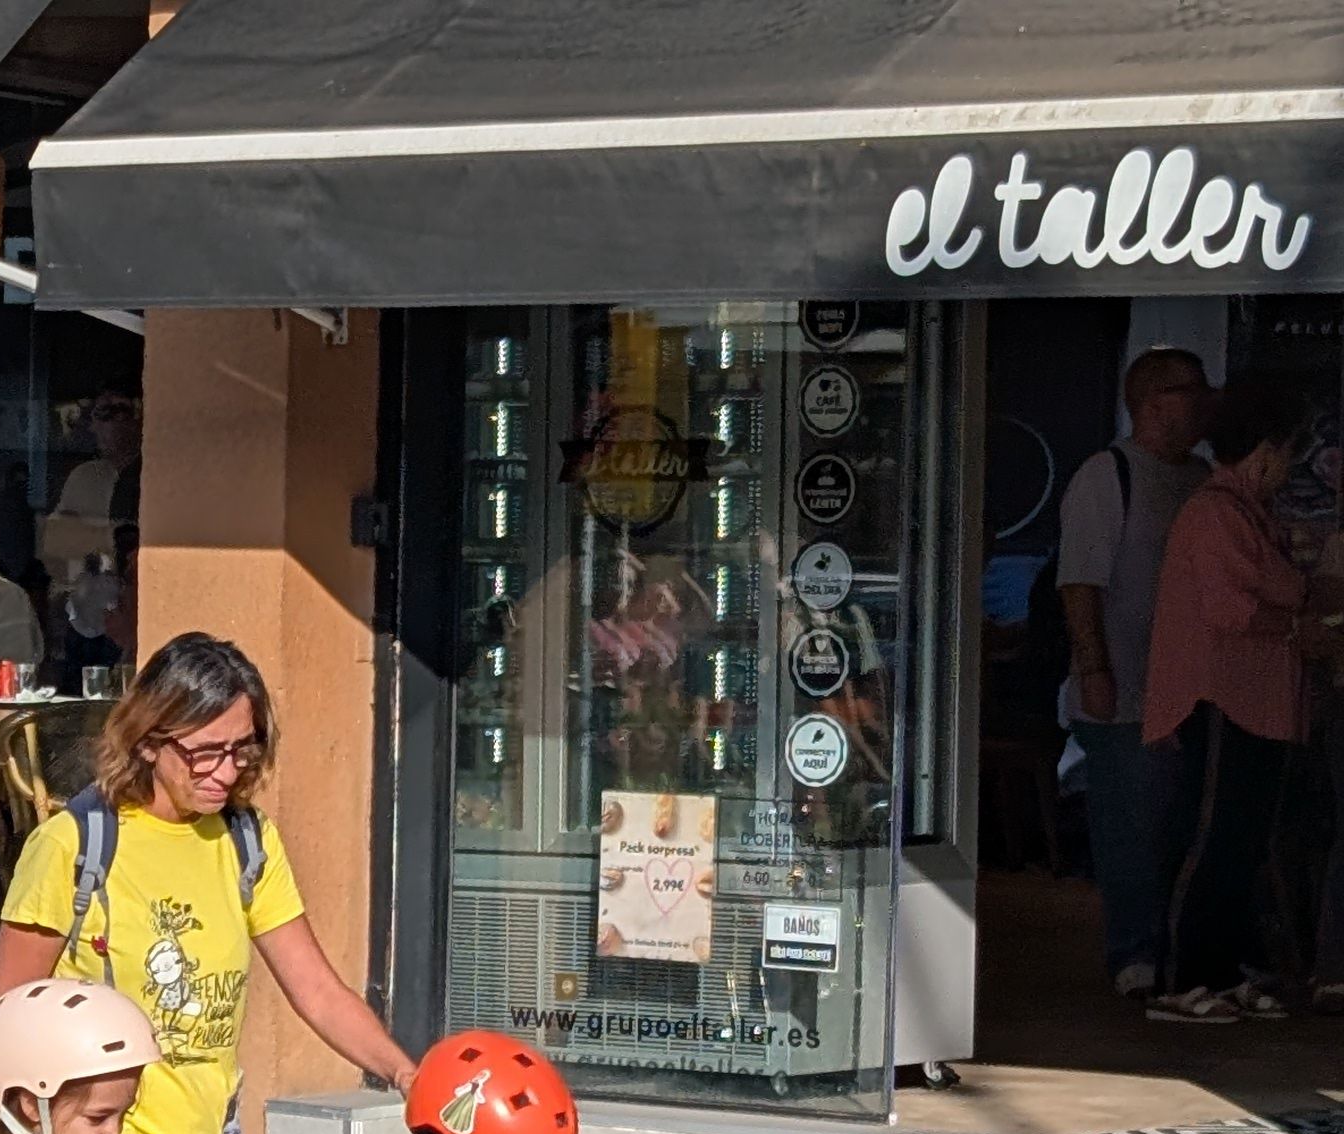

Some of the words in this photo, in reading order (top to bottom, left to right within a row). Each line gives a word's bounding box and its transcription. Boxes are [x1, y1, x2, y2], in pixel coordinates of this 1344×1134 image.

[885, 153, 983, 277] el
[993, 147, 1310, 271] taller
[619, 841, 645, 854] Pack
